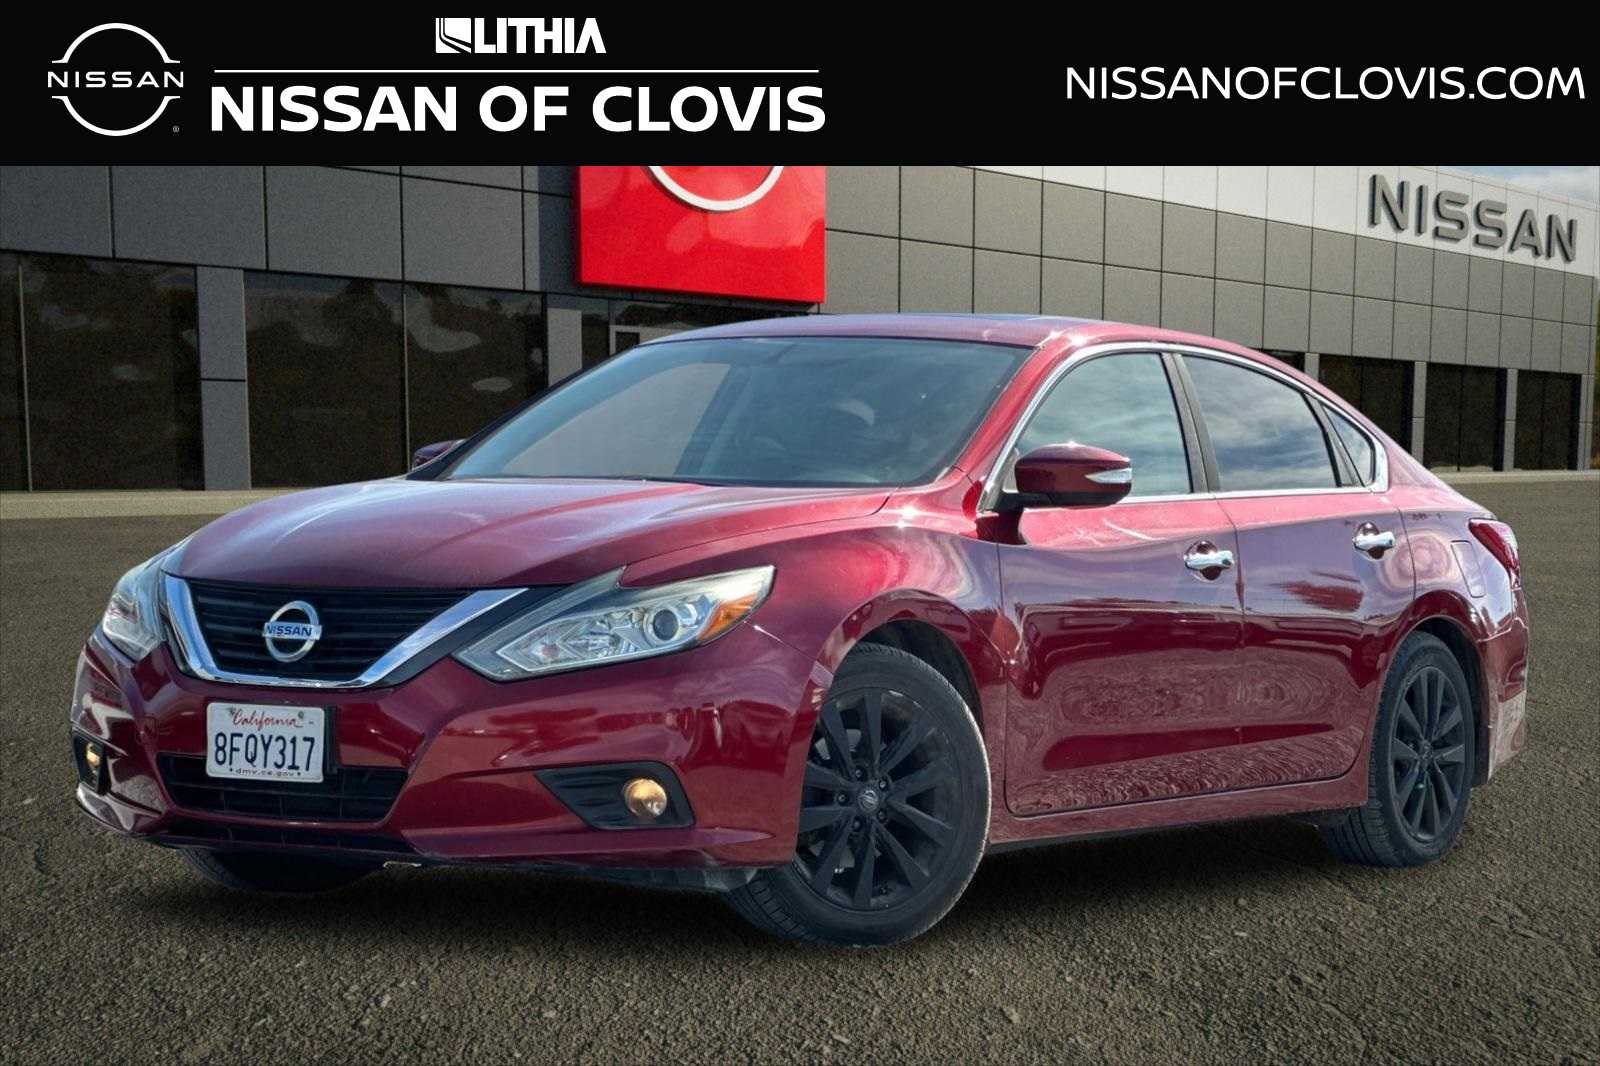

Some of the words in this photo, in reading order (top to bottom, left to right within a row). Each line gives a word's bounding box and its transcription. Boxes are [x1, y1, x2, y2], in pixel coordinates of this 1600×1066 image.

[1368, 173, 1578, 263] NISSAN
[267, 625, 312, 637] NISSAN
[232, 708, 303, 731] California
[214, 732, 315, 771] 8FQY317
